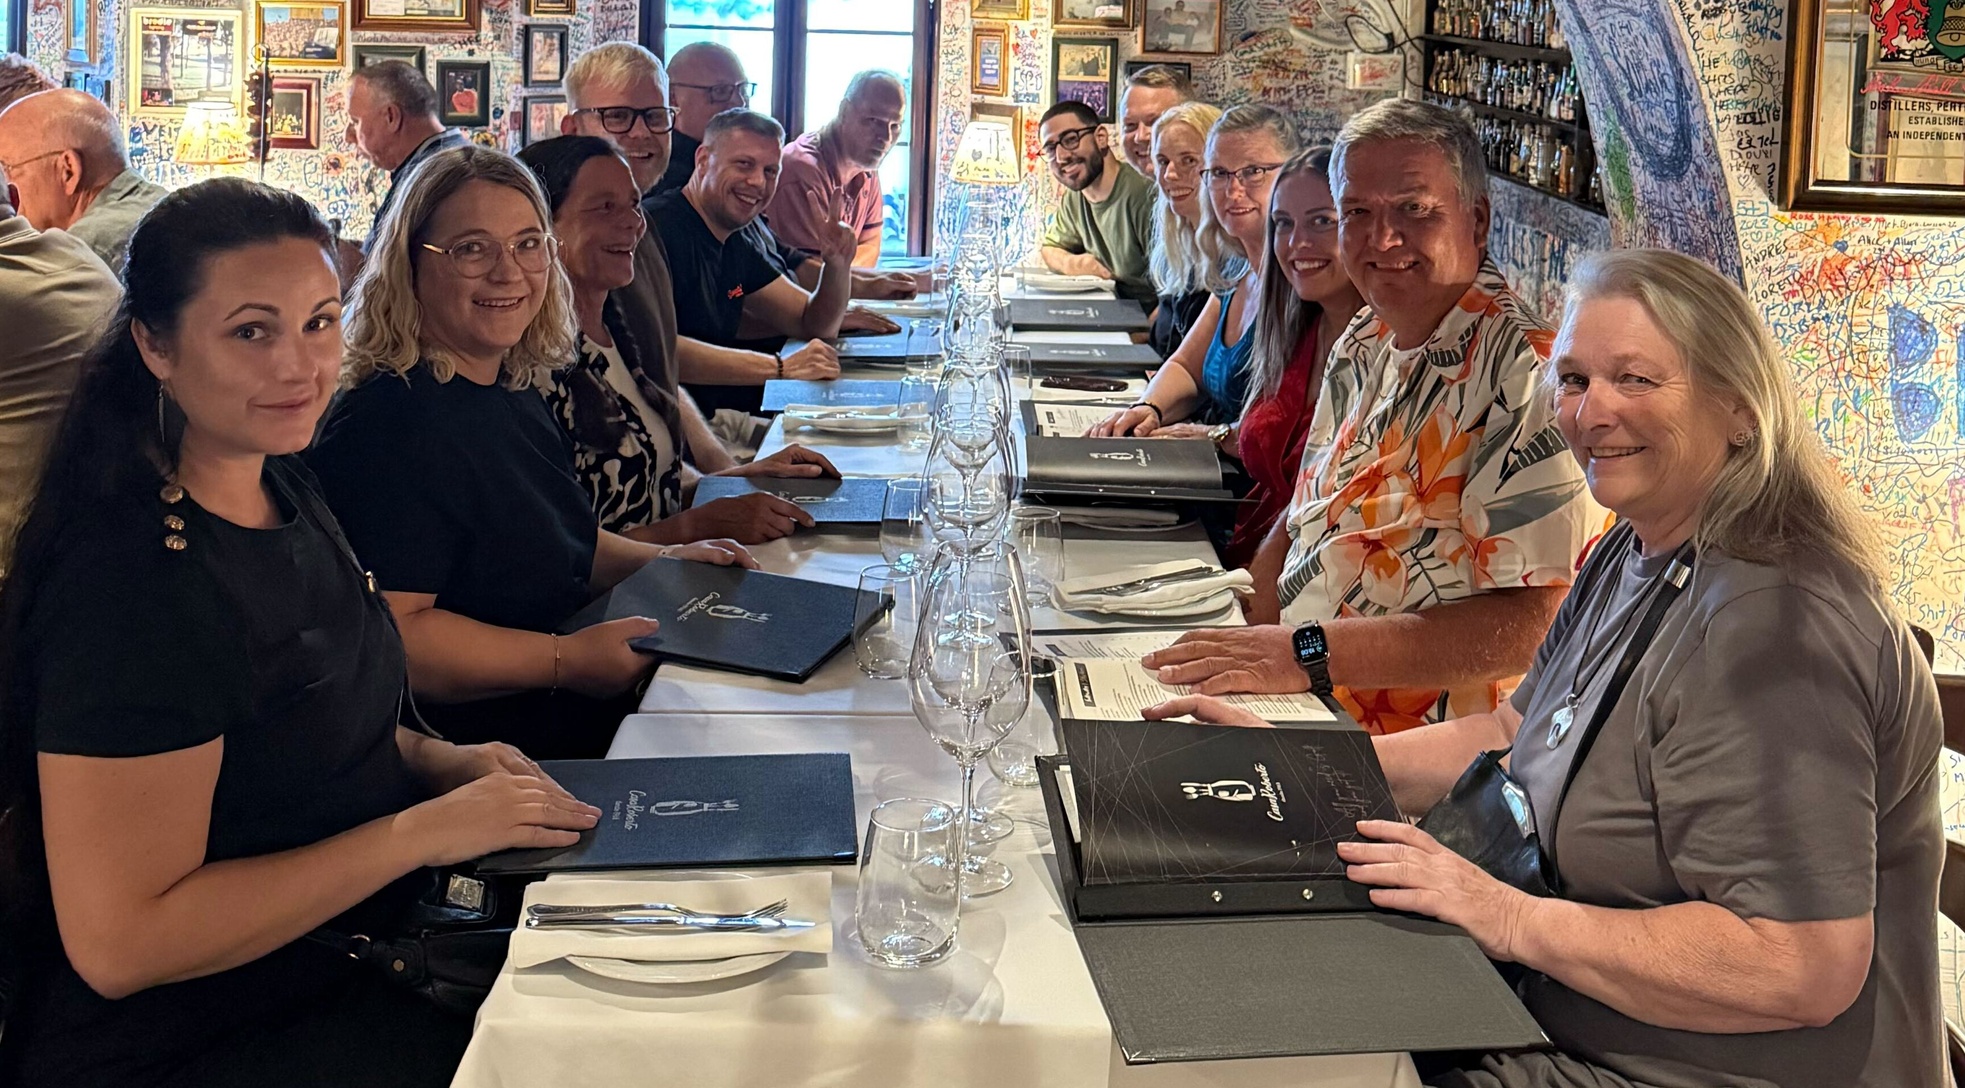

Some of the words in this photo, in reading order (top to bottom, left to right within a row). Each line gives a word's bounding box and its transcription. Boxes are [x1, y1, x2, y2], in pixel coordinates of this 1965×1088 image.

[1870, 100, 1934, 113] DISTILLERS,
[1908, 115, 1965, 126] ESTABLISHE
[1887, 131, 1899, 139] AN
[1902, 131, 1965, 141] INDEPENDENT
[1745, 238, 1788, 270] ANDRES
[1917, 600, 1947, 623] Shit
